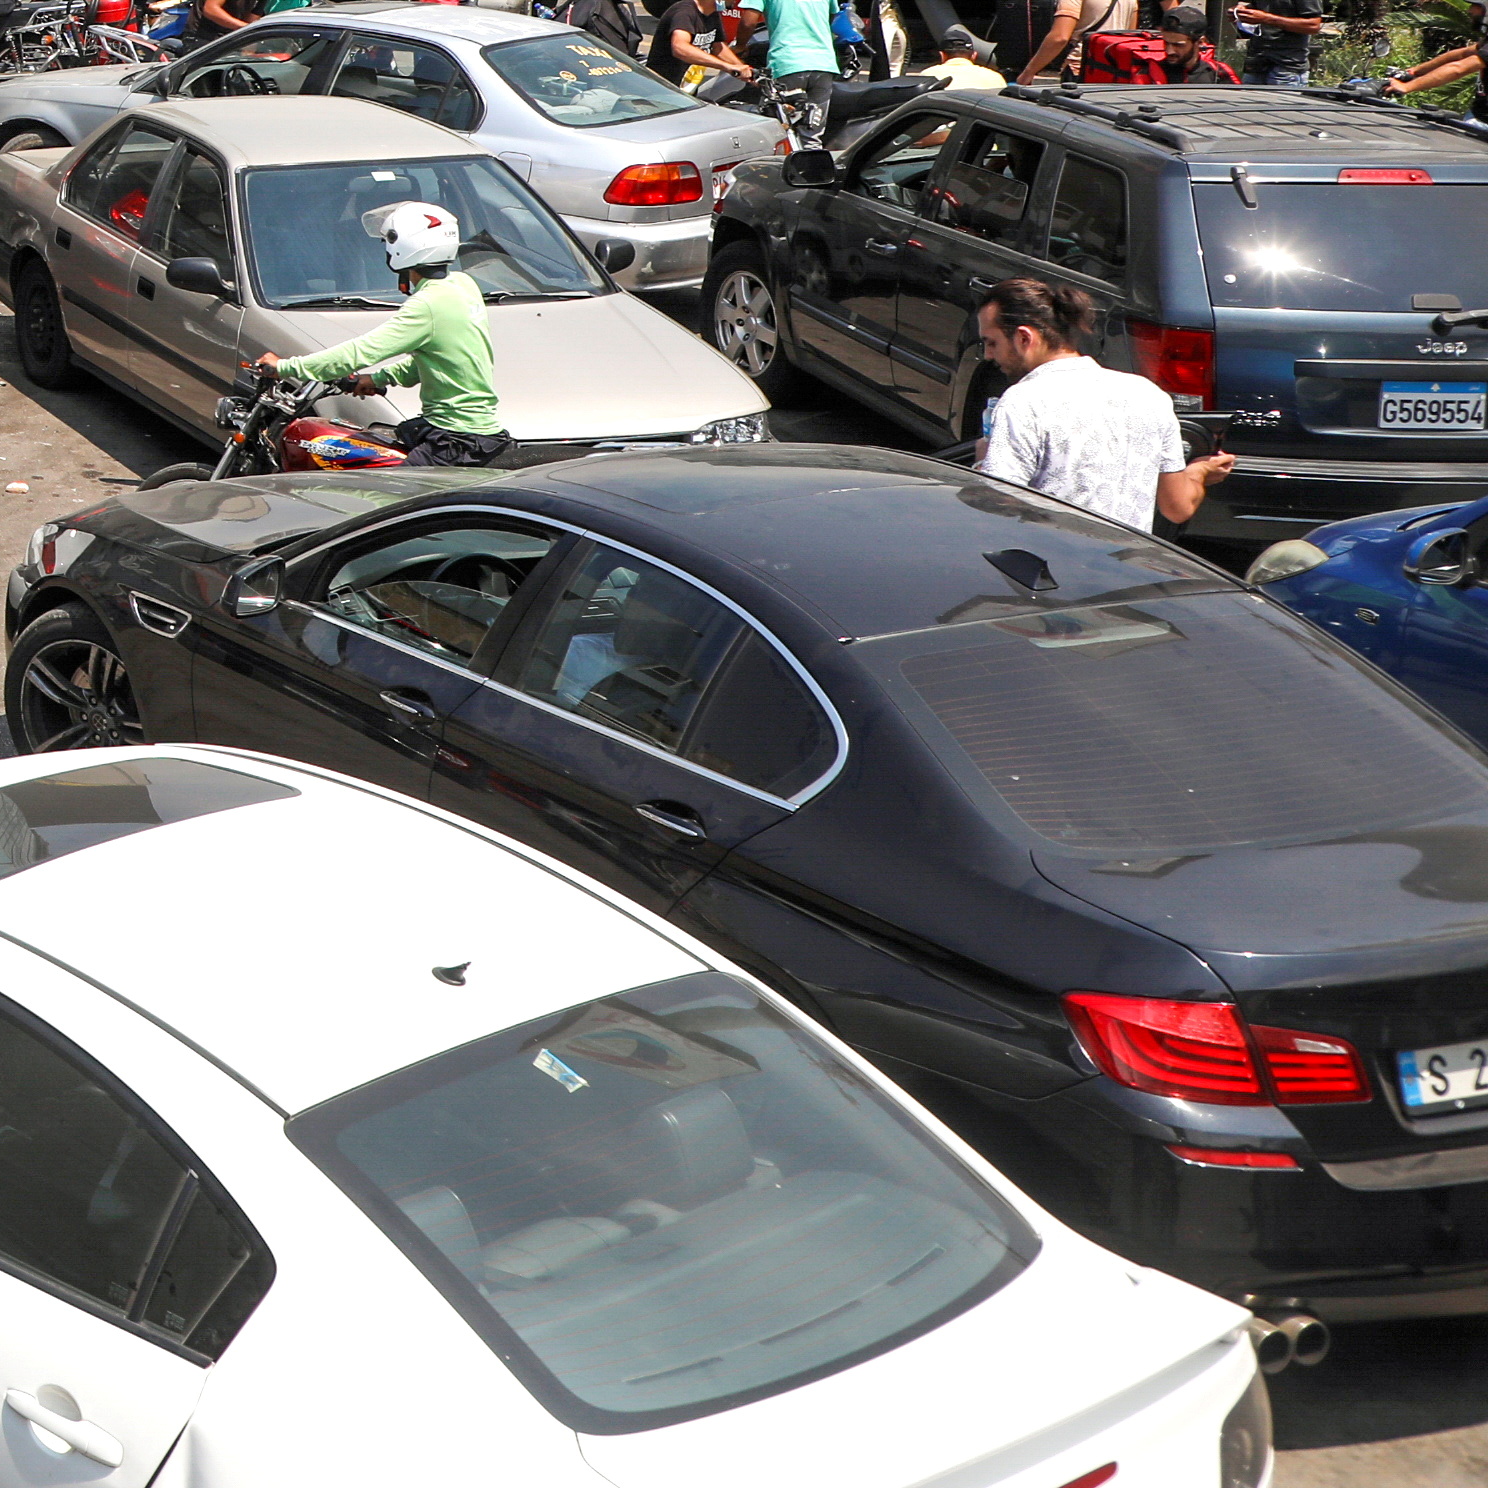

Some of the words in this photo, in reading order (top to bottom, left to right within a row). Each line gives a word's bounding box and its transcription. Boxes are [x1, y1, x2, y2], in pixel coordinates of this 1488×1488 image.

[565, 44, 613, 60] TAXI
[1416, 337, 1468, 358] Jeep
[1381, 398, 1484, 426] G569554
[1427, 1053, 1449, 1097] S
